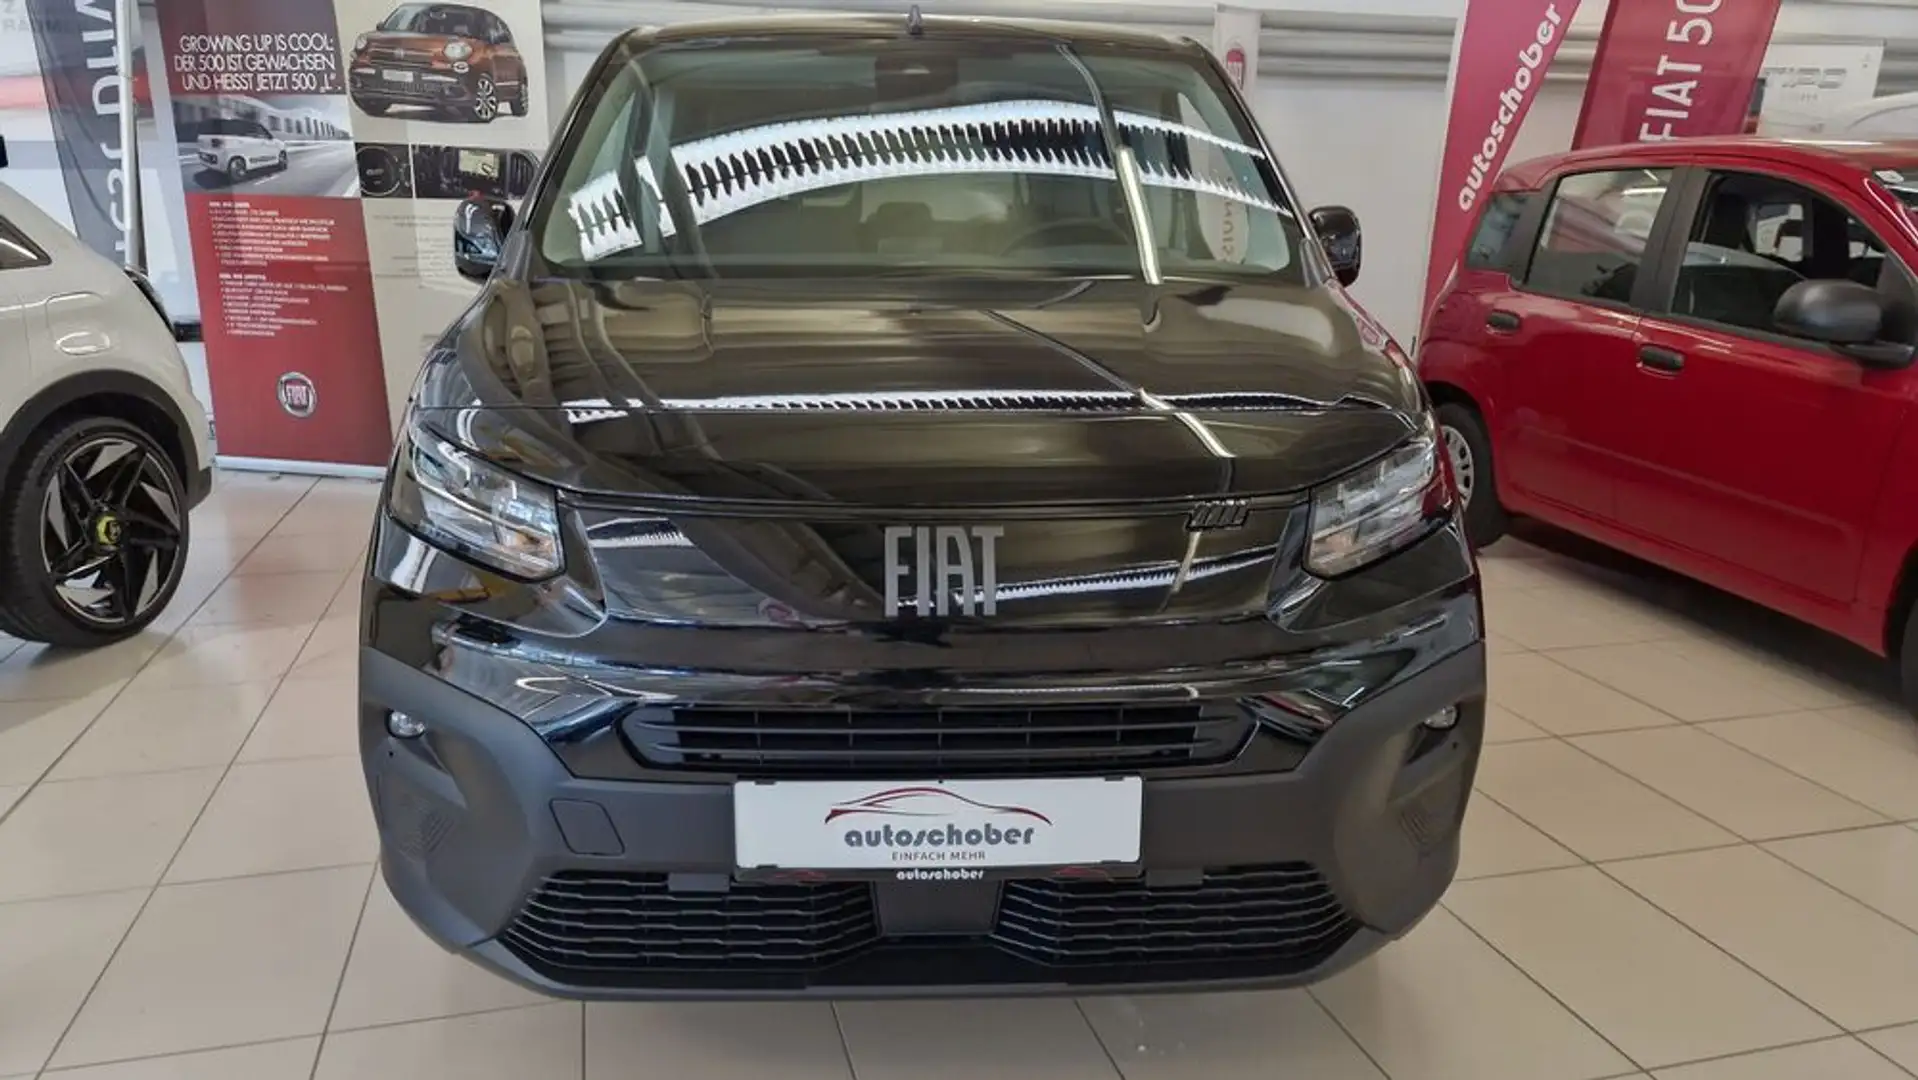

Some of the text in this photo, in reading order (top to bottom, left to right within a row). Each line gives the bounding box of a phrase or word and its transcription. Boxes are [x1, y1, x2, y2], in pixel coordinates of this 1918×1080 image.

[179, 32, 335, 52] GROWING UP IS COOL:
[174, 53, 336, 72] DER 500 IST GEWACHSEN
[182, 74, 211, 91] UND
[214, 73, 254, 91] HEISST
[256, 73, 288, 92] JETZT
[291, 73, 316, 91] 500
[1458, 3, 1561, 211] autoschober
[1639, 54, 1702, 142] FIAT
[884, 525, 1004, 617] FIAT
[844, 823, 1035, 847] autoschober
[892, 851, 985, 861] EINFACH MEHR
[896, 868, 984, 880] autoschober
